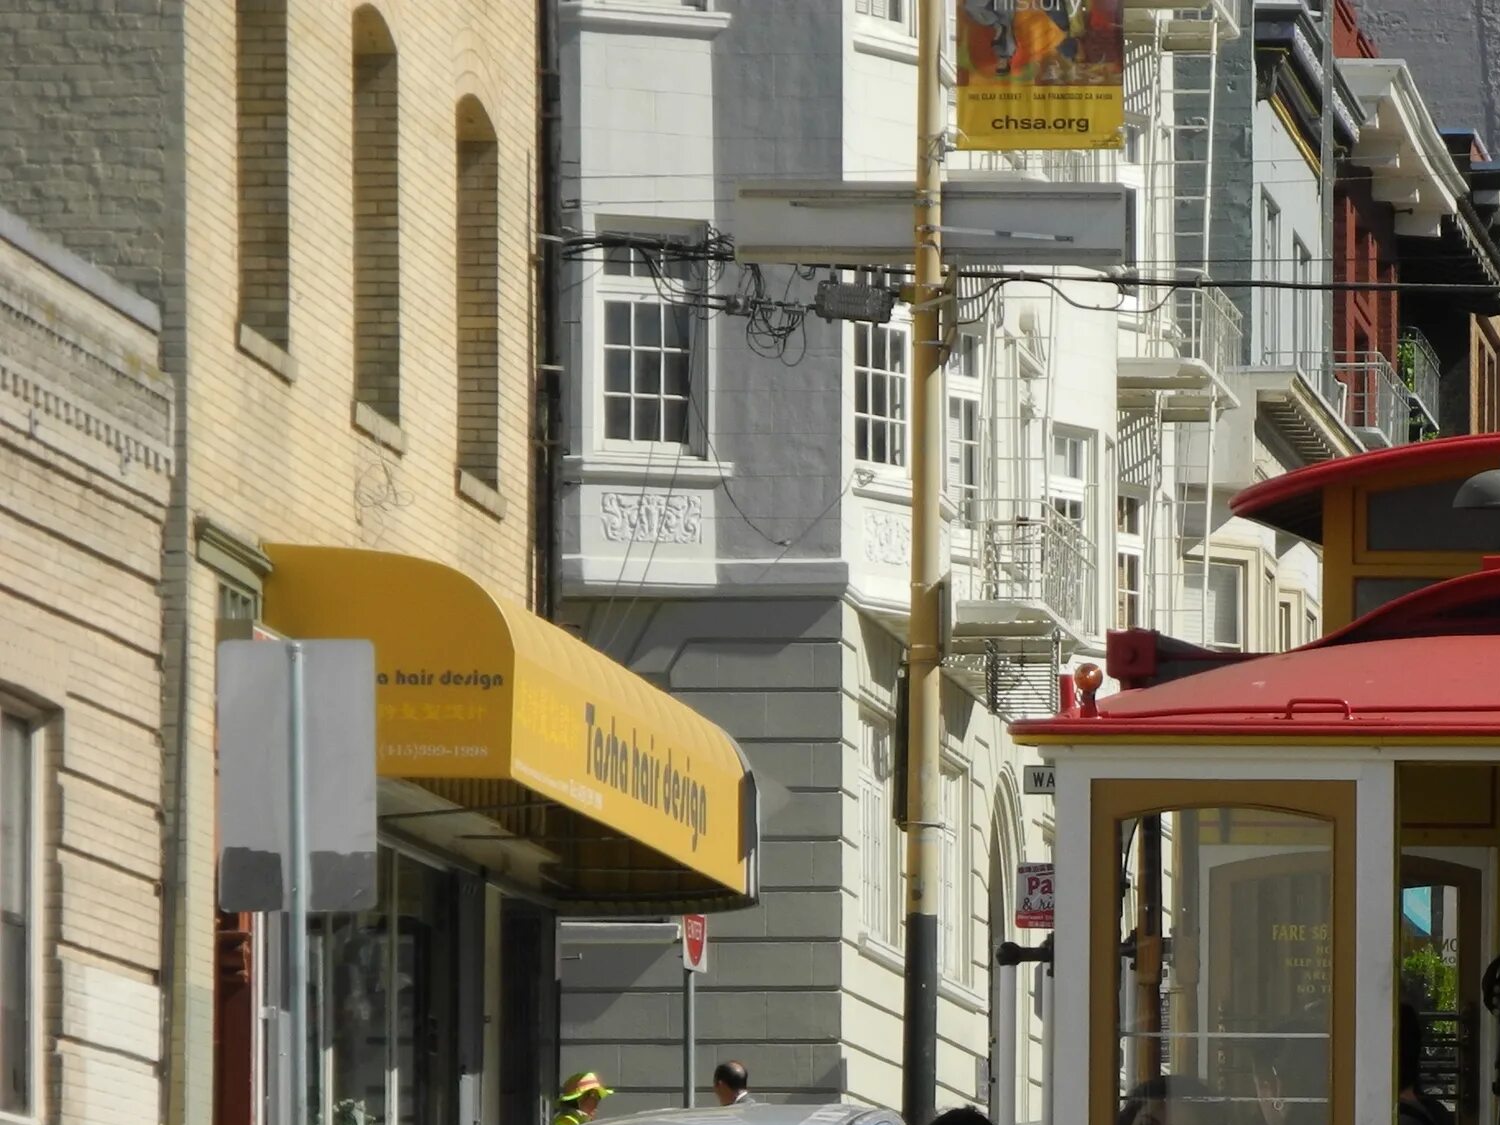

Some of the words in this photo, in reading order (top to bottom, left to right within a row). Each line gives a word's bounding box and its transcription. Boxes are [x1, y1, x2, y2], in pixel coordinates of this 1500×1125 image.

[991, 115, 1089, 132] chsa.org
[395, 669, 434, 686] hair
[439, 669, 504, 690] design
[585, 702, 629, 795] Tasha
[632, 727, 661, 810] hair
[663, 747, 707, 853] design
[1272, 924, 1305, 941] FARE
